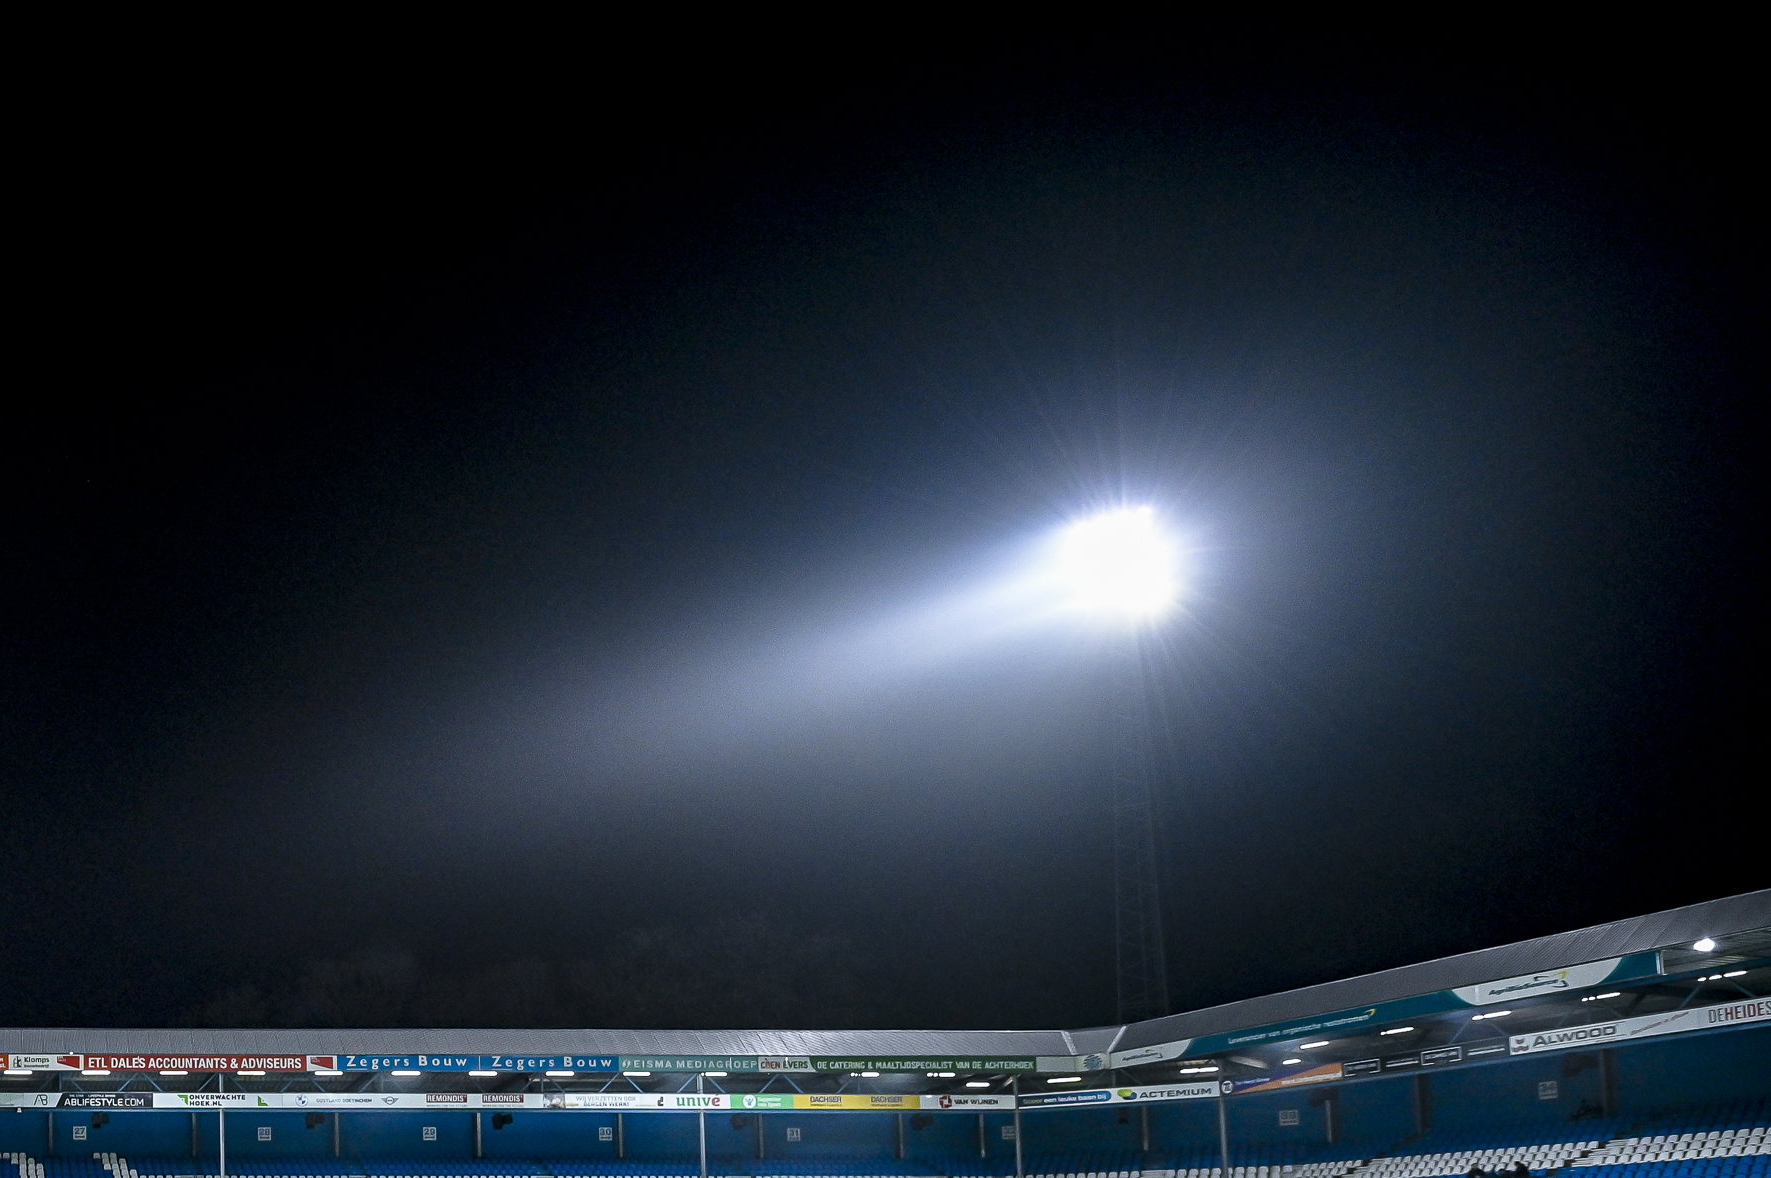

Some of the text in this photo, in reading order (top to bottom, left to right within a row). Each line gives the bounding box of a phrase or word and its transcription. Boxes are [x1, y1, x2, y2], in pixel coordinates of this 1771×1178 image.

[23, 1056, 50, 1065] Klomps
[88, 1057, 108, 1069] ETL
[148, 1057, 228, 1070] ACCOUNTANTS
[229, 1057, 238, 1070] &
[240, 1057, 302, 1070] ADVISEURS
[346, 1055, 468, 1070] Zegers Bouw
[491, 1056, 613, 1071] Zegers Bouw
[633, 1059, 758, 1069] EISMA MEDIAGROEP
[816, 1060, 1034, 1071] DE CATERING & MAALTIJDSPECIALIST VAN DE ACHTERHOEK
[1139, 1087, 1212, 1100] ACTEMIUM
[676, 1095, 721, 1107] univé
